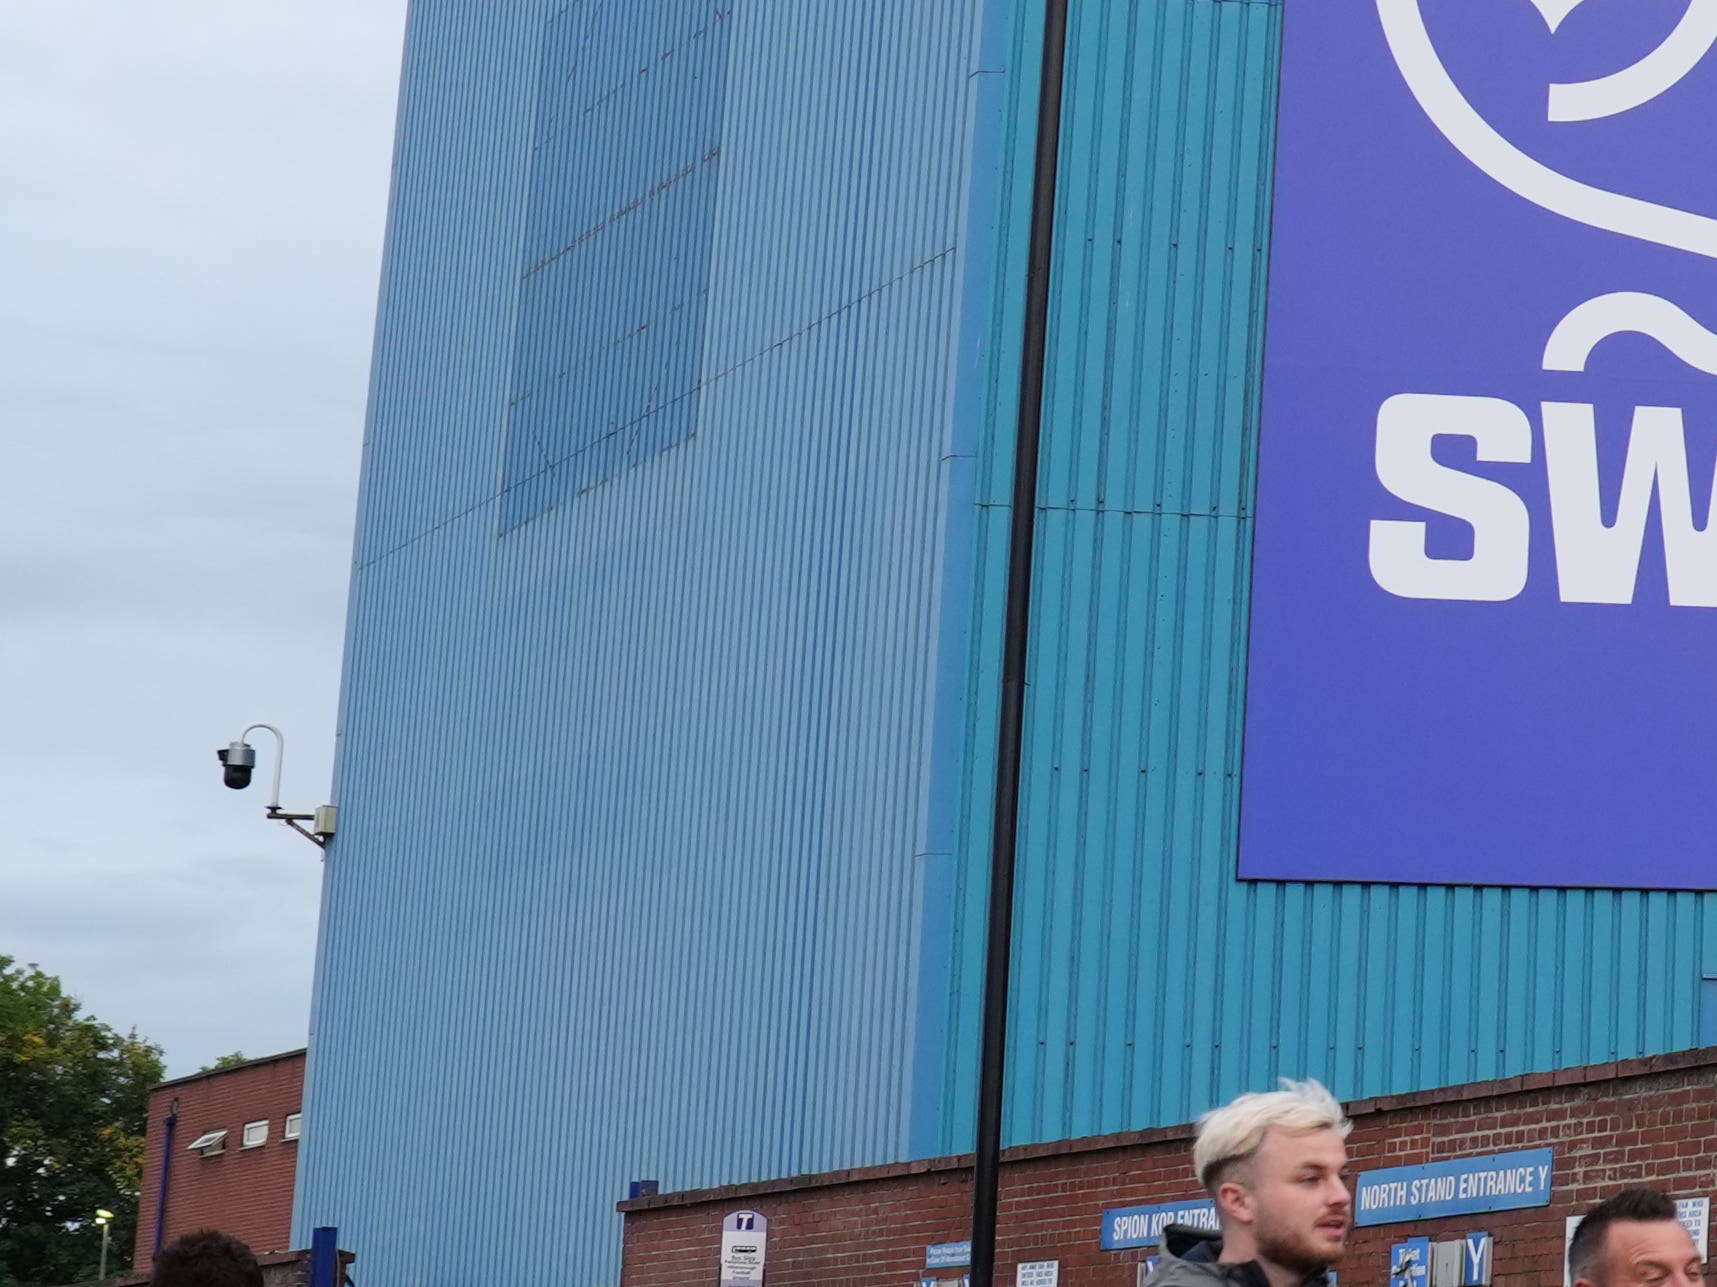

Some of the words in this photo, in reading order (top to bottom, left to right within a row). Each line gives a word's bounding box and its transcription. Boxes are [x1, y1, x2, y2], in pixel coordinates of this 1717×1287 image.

[1360, 1182, 1407, 1210] NORTH
[1410, 1175, 1455, 1205] STAND
[1458, 1166, 1535, 1199] ENTRANCE
[1538, 1165, 1549, 1190] Y
[738, 1213, 753, 1230] T
[1113, 1214, 1149, 1240] SPION
[1467, 1237, 1487, 1281] Y
